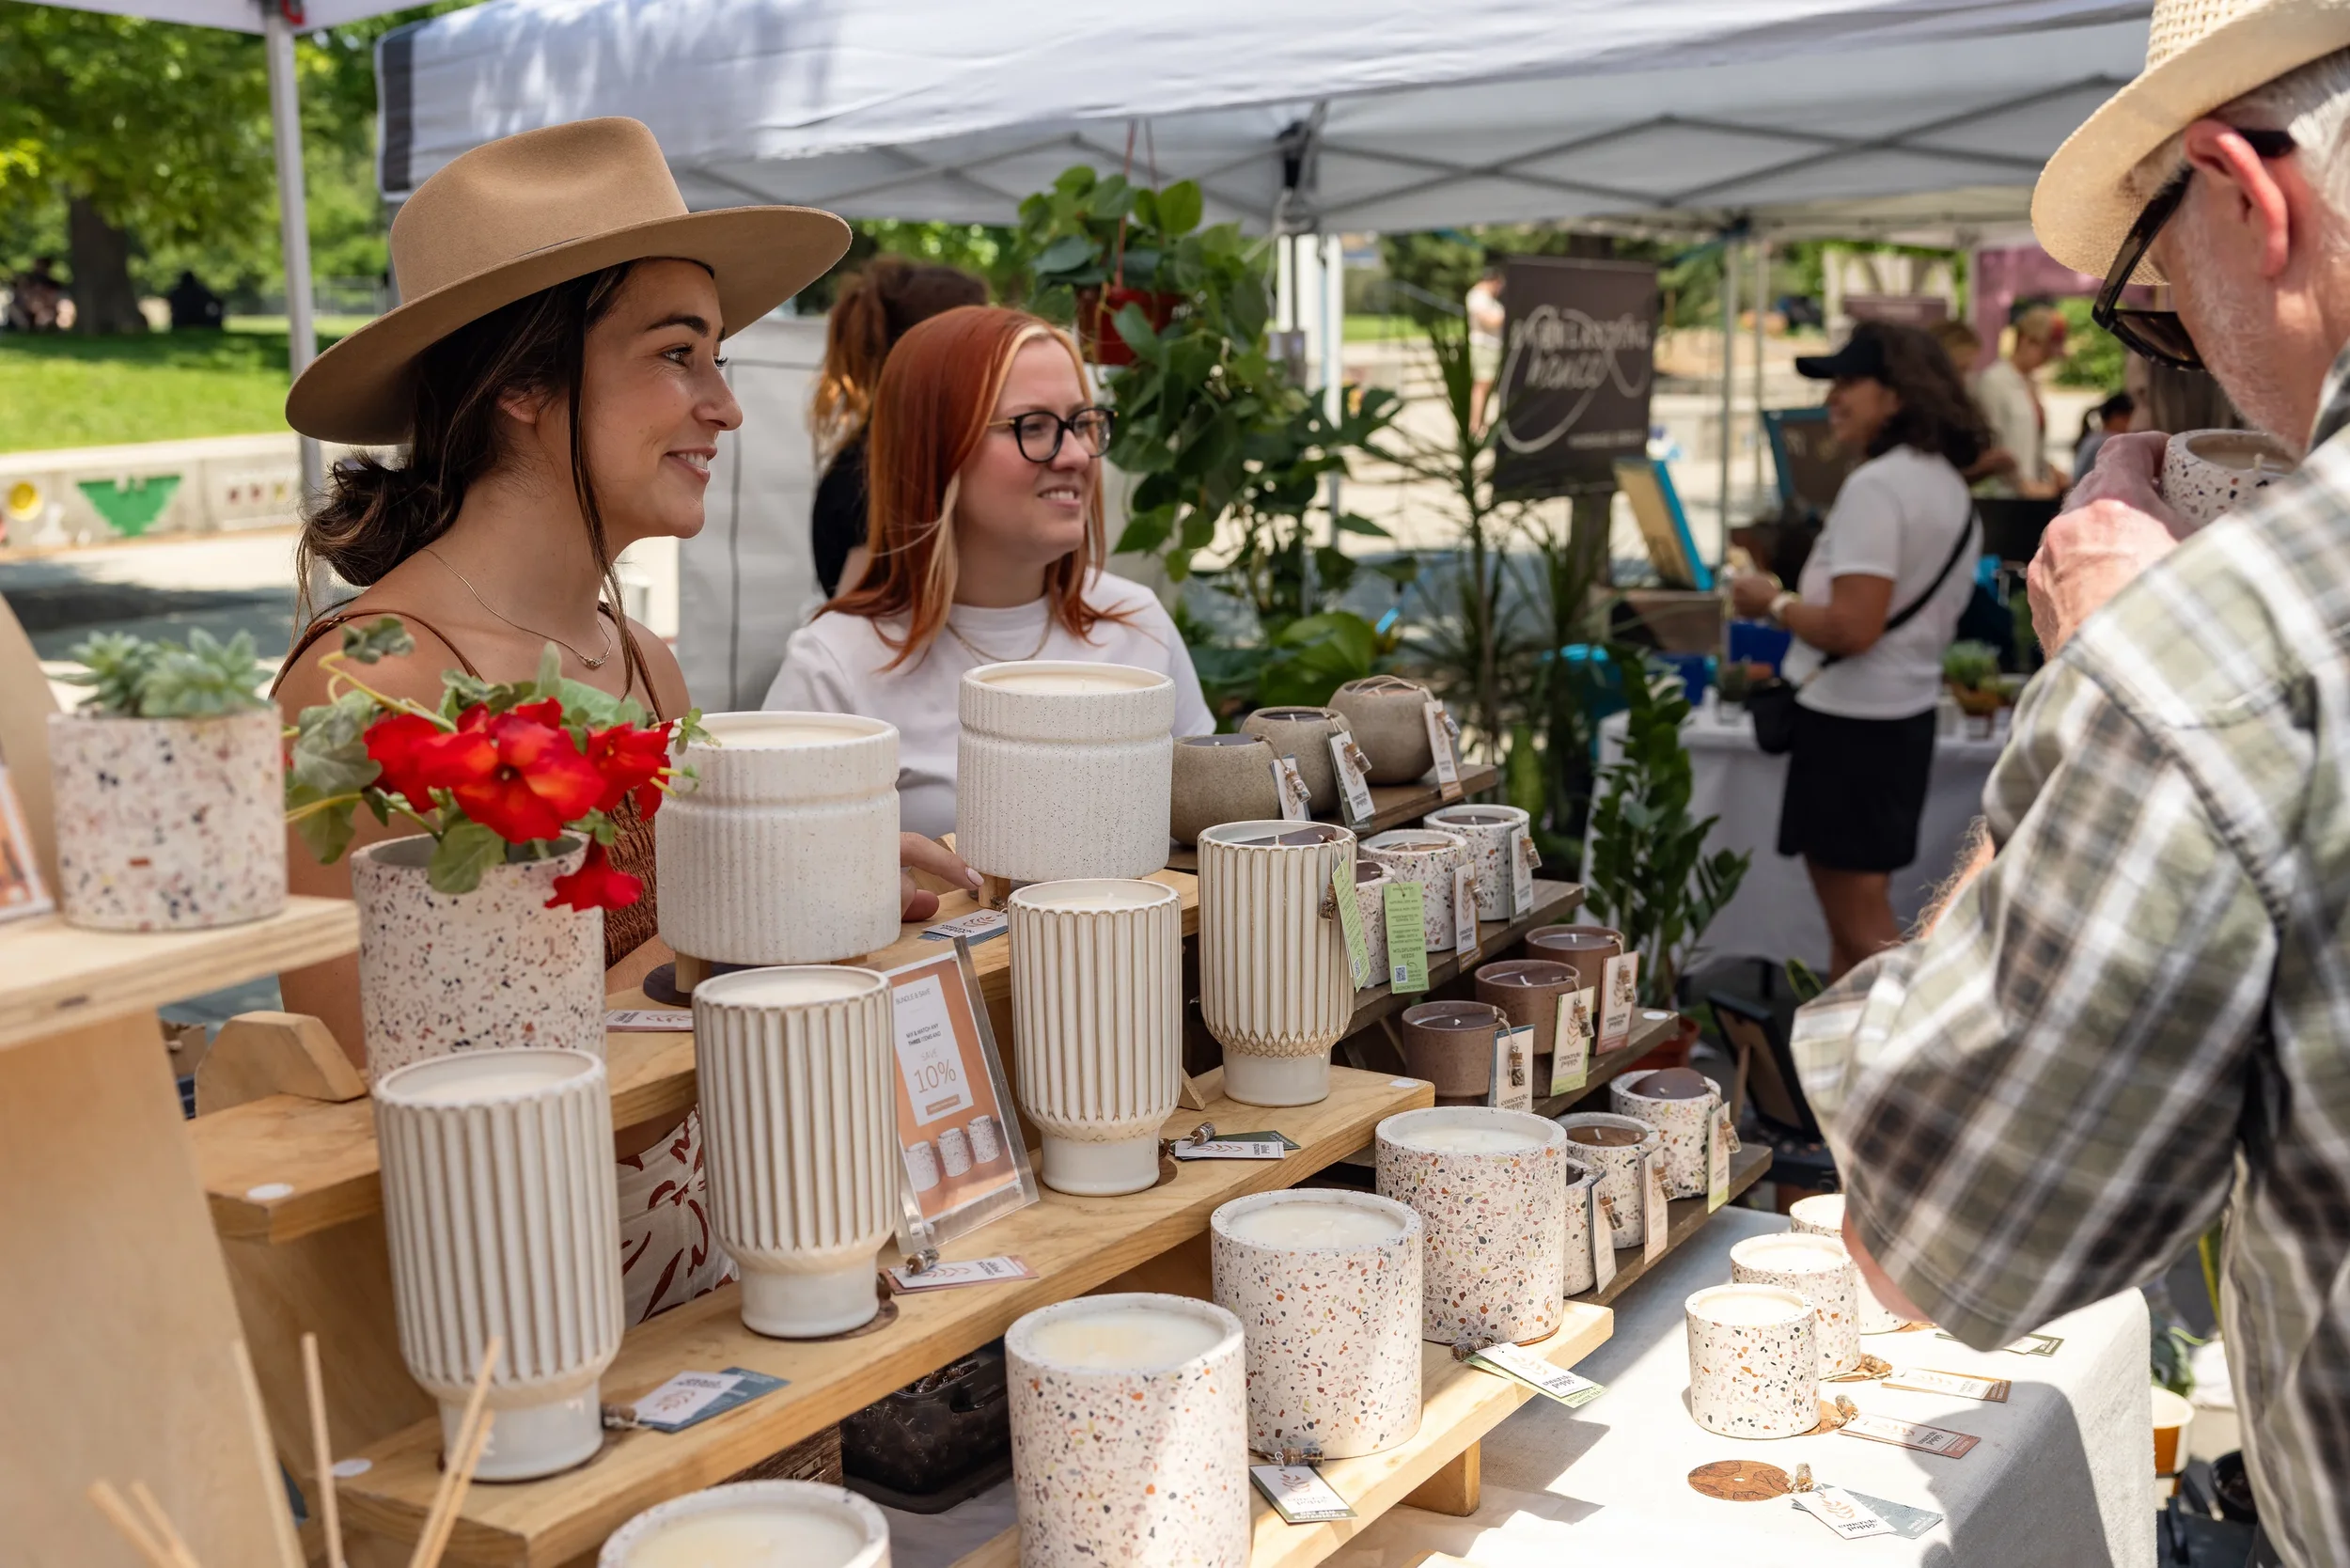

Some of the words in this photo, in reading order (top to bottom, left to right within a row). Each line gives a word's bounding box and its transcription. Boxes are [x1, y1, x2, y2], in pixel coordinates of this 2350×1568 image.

[916, 1026, 931, 1034] MATCH
[908, 1038, 921, 1046] THREE
[921, 1033, 932, 1043] ITEMS
[932, 1030, 942, 1039] AND
[920, 1047, 938, 1062] SAVE
[1559, 1052, 1582, 1062] concrete
[914, 1058, 957, 1094] 10%
[1500, 1093, 1528, 1106] concrete
